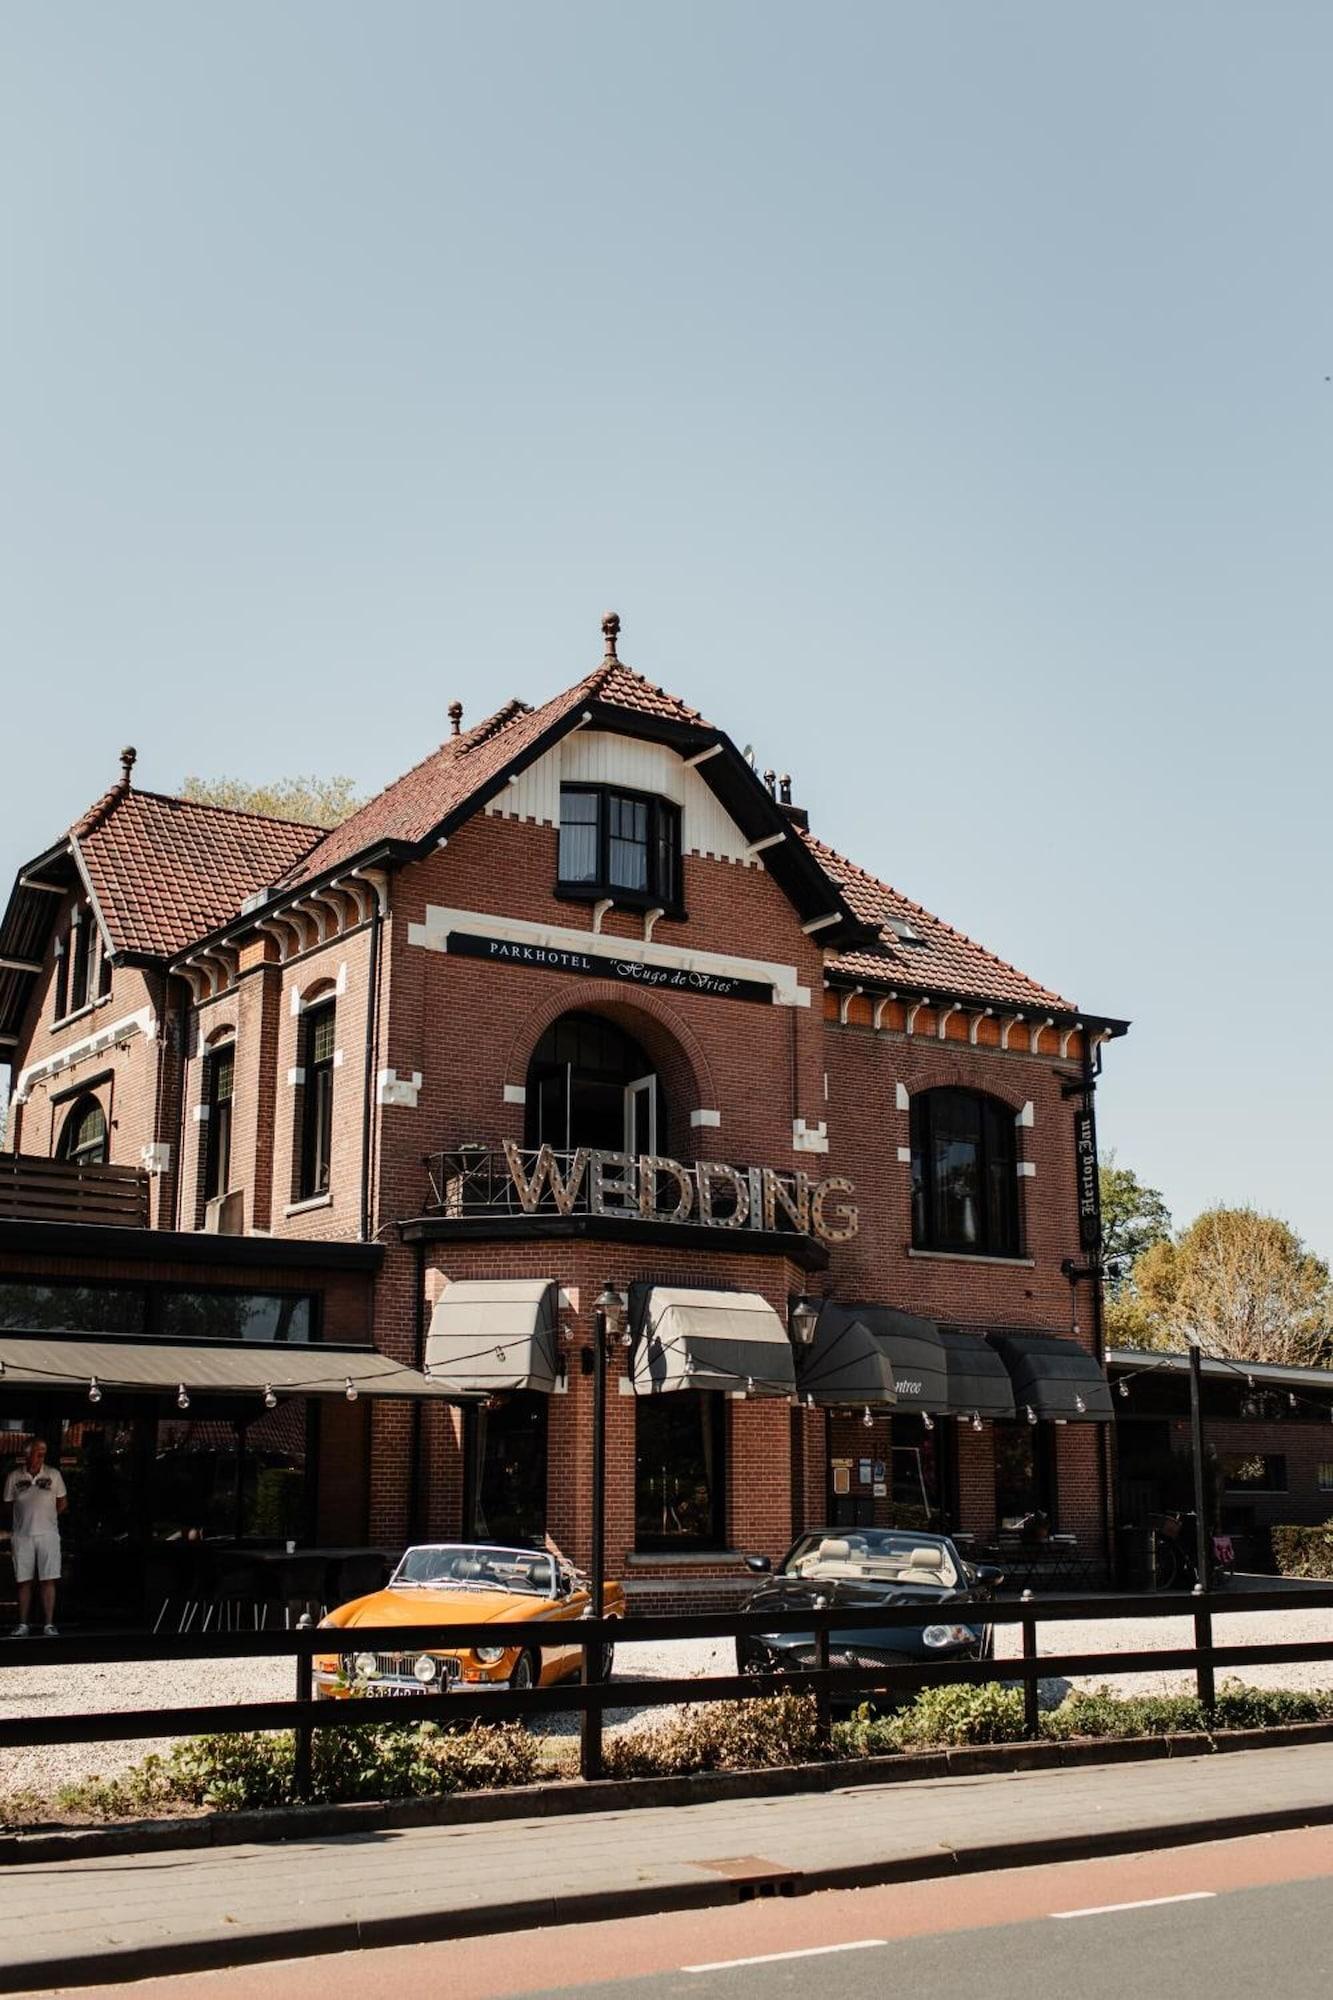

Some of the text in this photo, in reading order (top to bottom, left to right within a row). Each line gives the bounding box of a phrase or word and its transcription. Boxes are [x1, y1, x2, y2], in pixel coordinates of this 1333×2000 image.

[490, 942, 591, 969] PARKHOTEL
[671, 971, 686, 985] de
[502, 1139, 858, 1243] WEDDING
[1079, 1119, 1098, 1217] Hertog Jan
[895, 1379, 922, 1394] ntree
